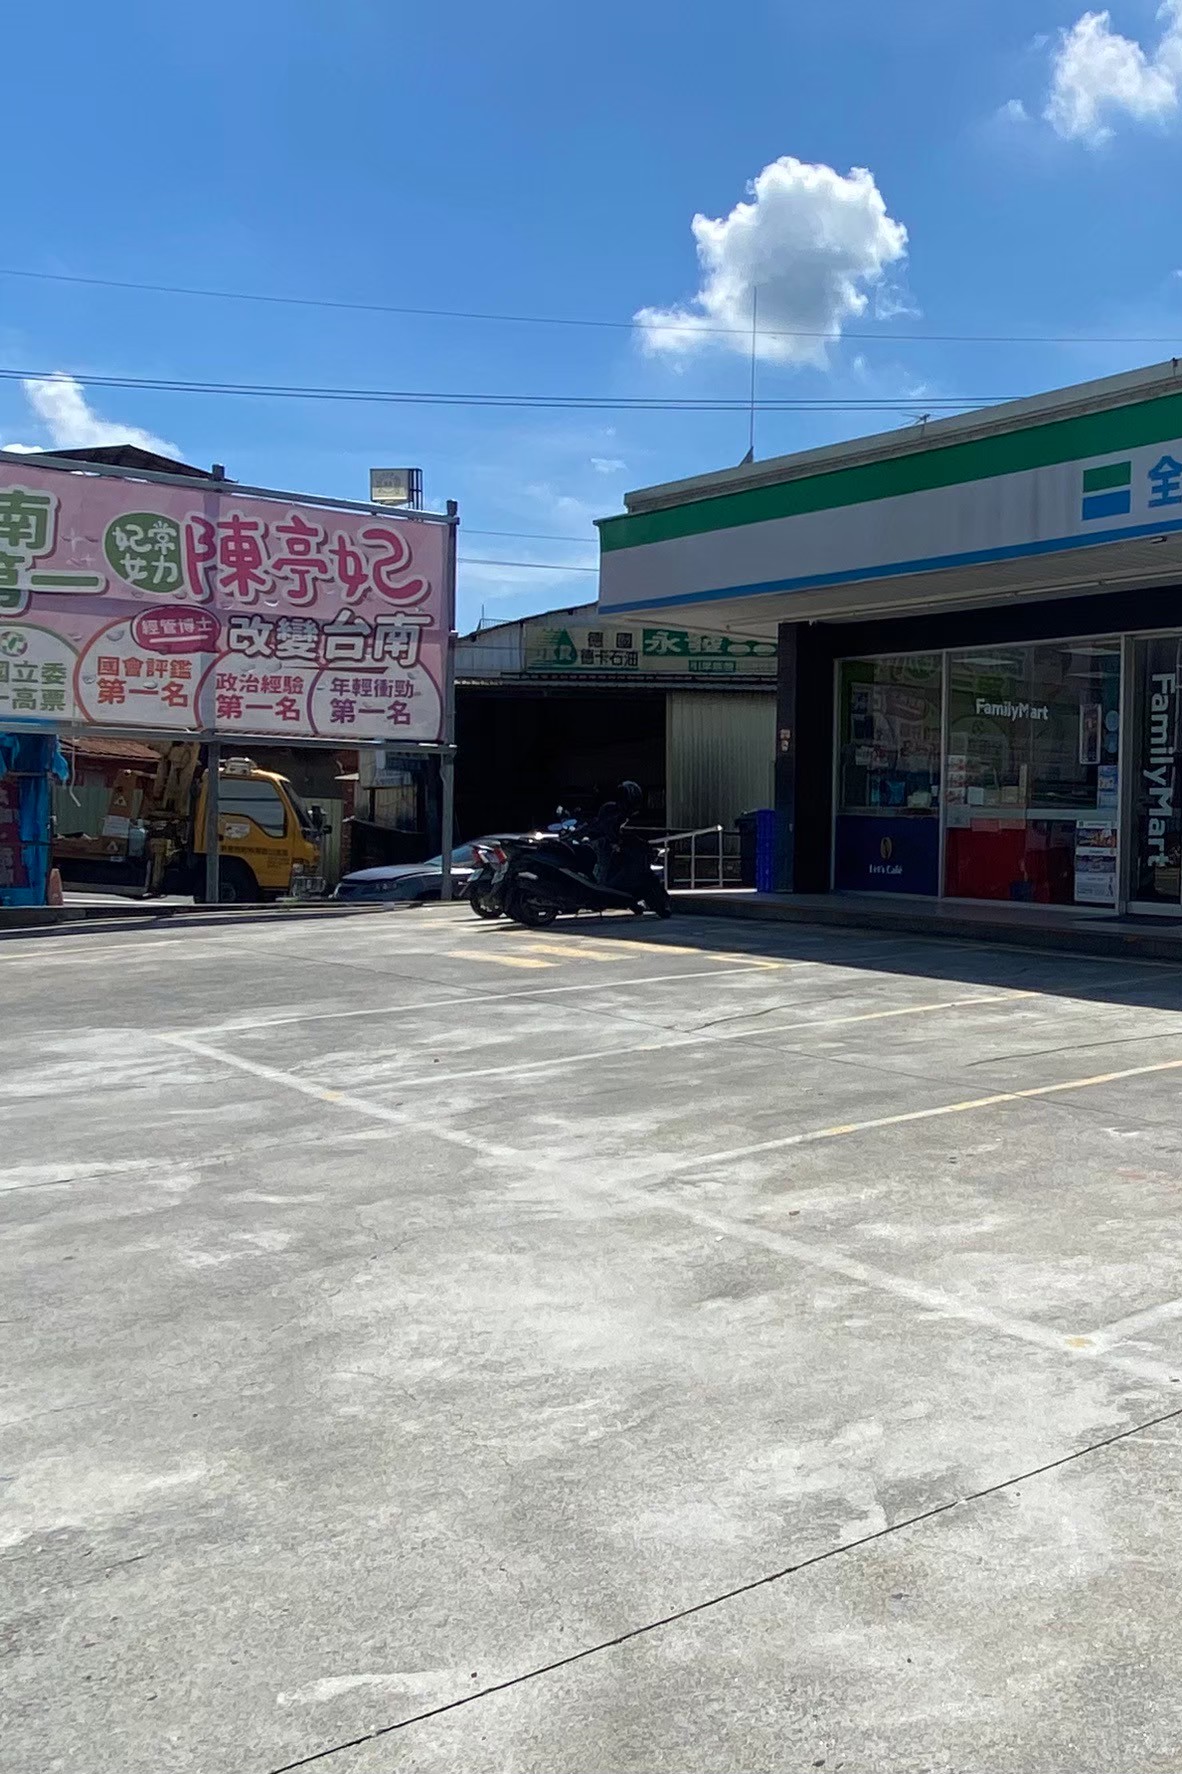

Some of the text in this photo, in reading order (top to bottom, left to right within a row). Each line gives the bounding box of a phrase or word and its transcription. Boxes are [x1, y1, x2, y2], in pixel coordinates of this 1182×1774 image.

[185, 514, 424, 599] 陳亭妃
[229, 609, 433, 666] 改變台南
[97, 656, 192, 679] 國會評鑑
[97, 678, 188, 707] 第一名
[215, 673, 304, 695] 政治經驗
[330, 677, 415, 699] 年輕衝勁
[216, 694, 300, 721] 第一名
[329, 698, 411, 725] 第一名
[975, 698, 1049, 721] FamilyMart
[1144, 672, 1176, 868] FamilyMart
